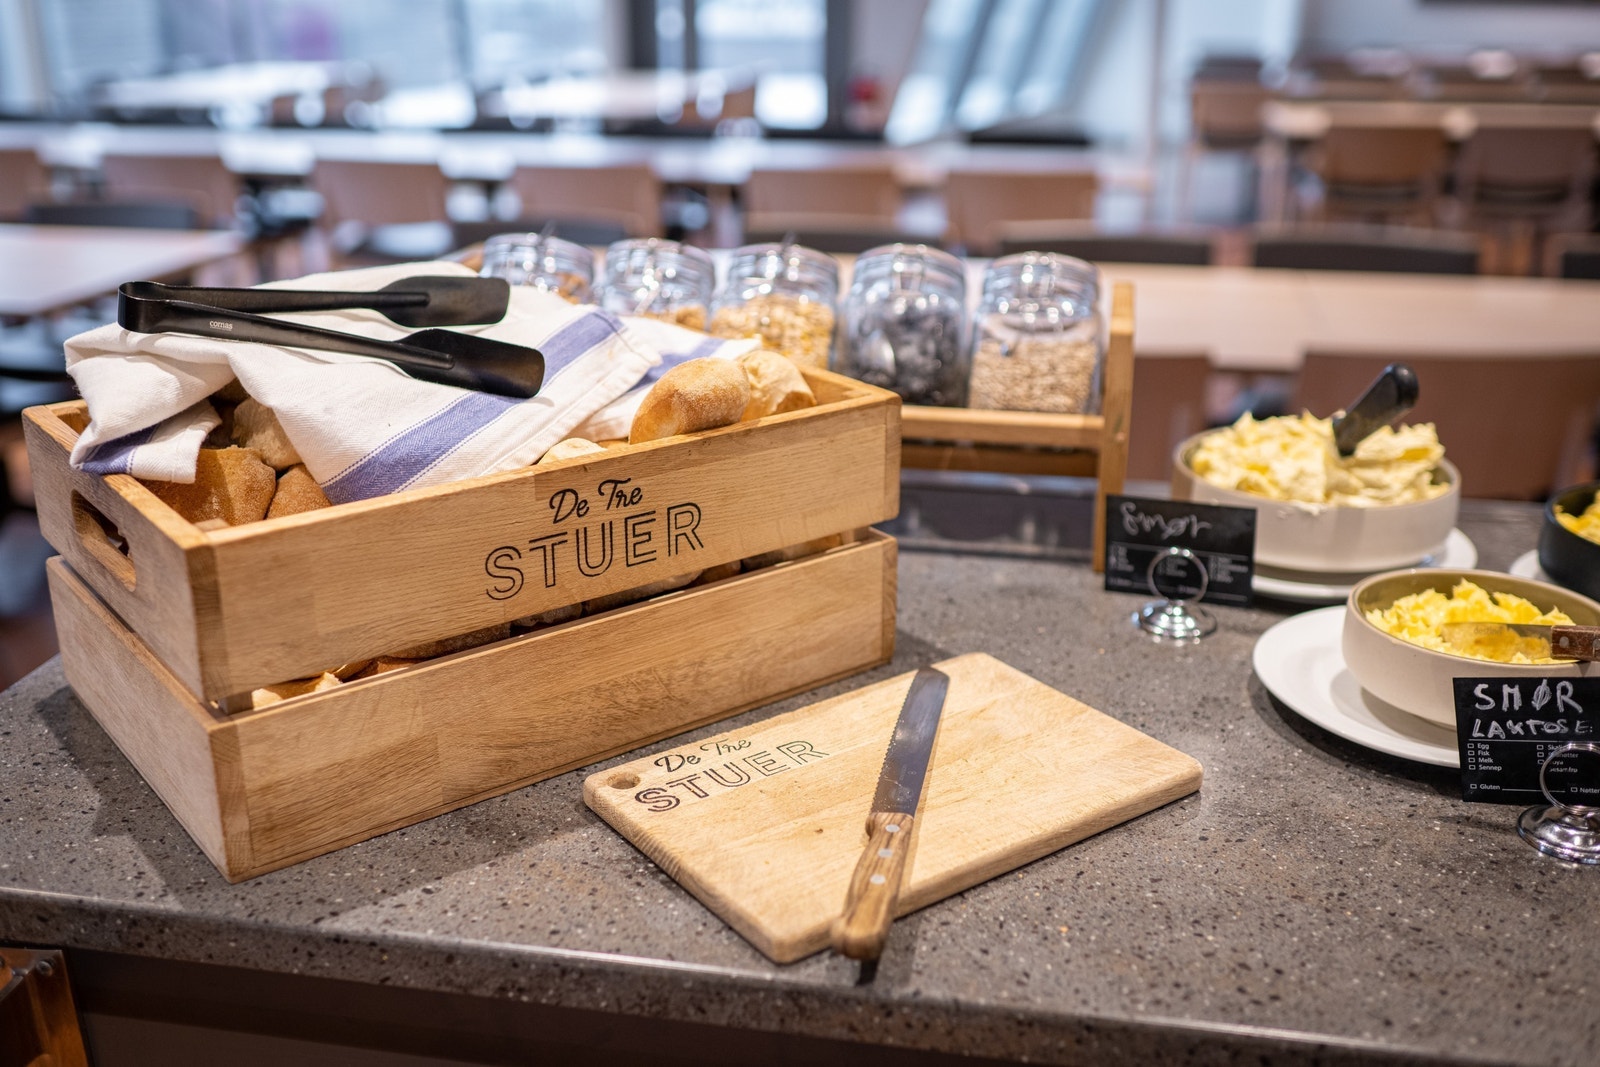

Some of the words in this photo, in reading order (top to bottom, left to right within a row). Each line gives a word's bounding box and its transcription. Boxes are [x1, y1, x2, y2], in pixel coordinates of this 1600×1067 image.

[549, 487, 590, 525] De
[597, 477, 643, 511] Tre
[484, 502, 705, 601] STUER
[1473, 678, 1584, 713] SMØR
[653, 753, 702, 773] De
[699, 738, 752, 756] Tre
[1478, 764, 1503, 772] Sennep
[634, 740, 830, 813] STUER
